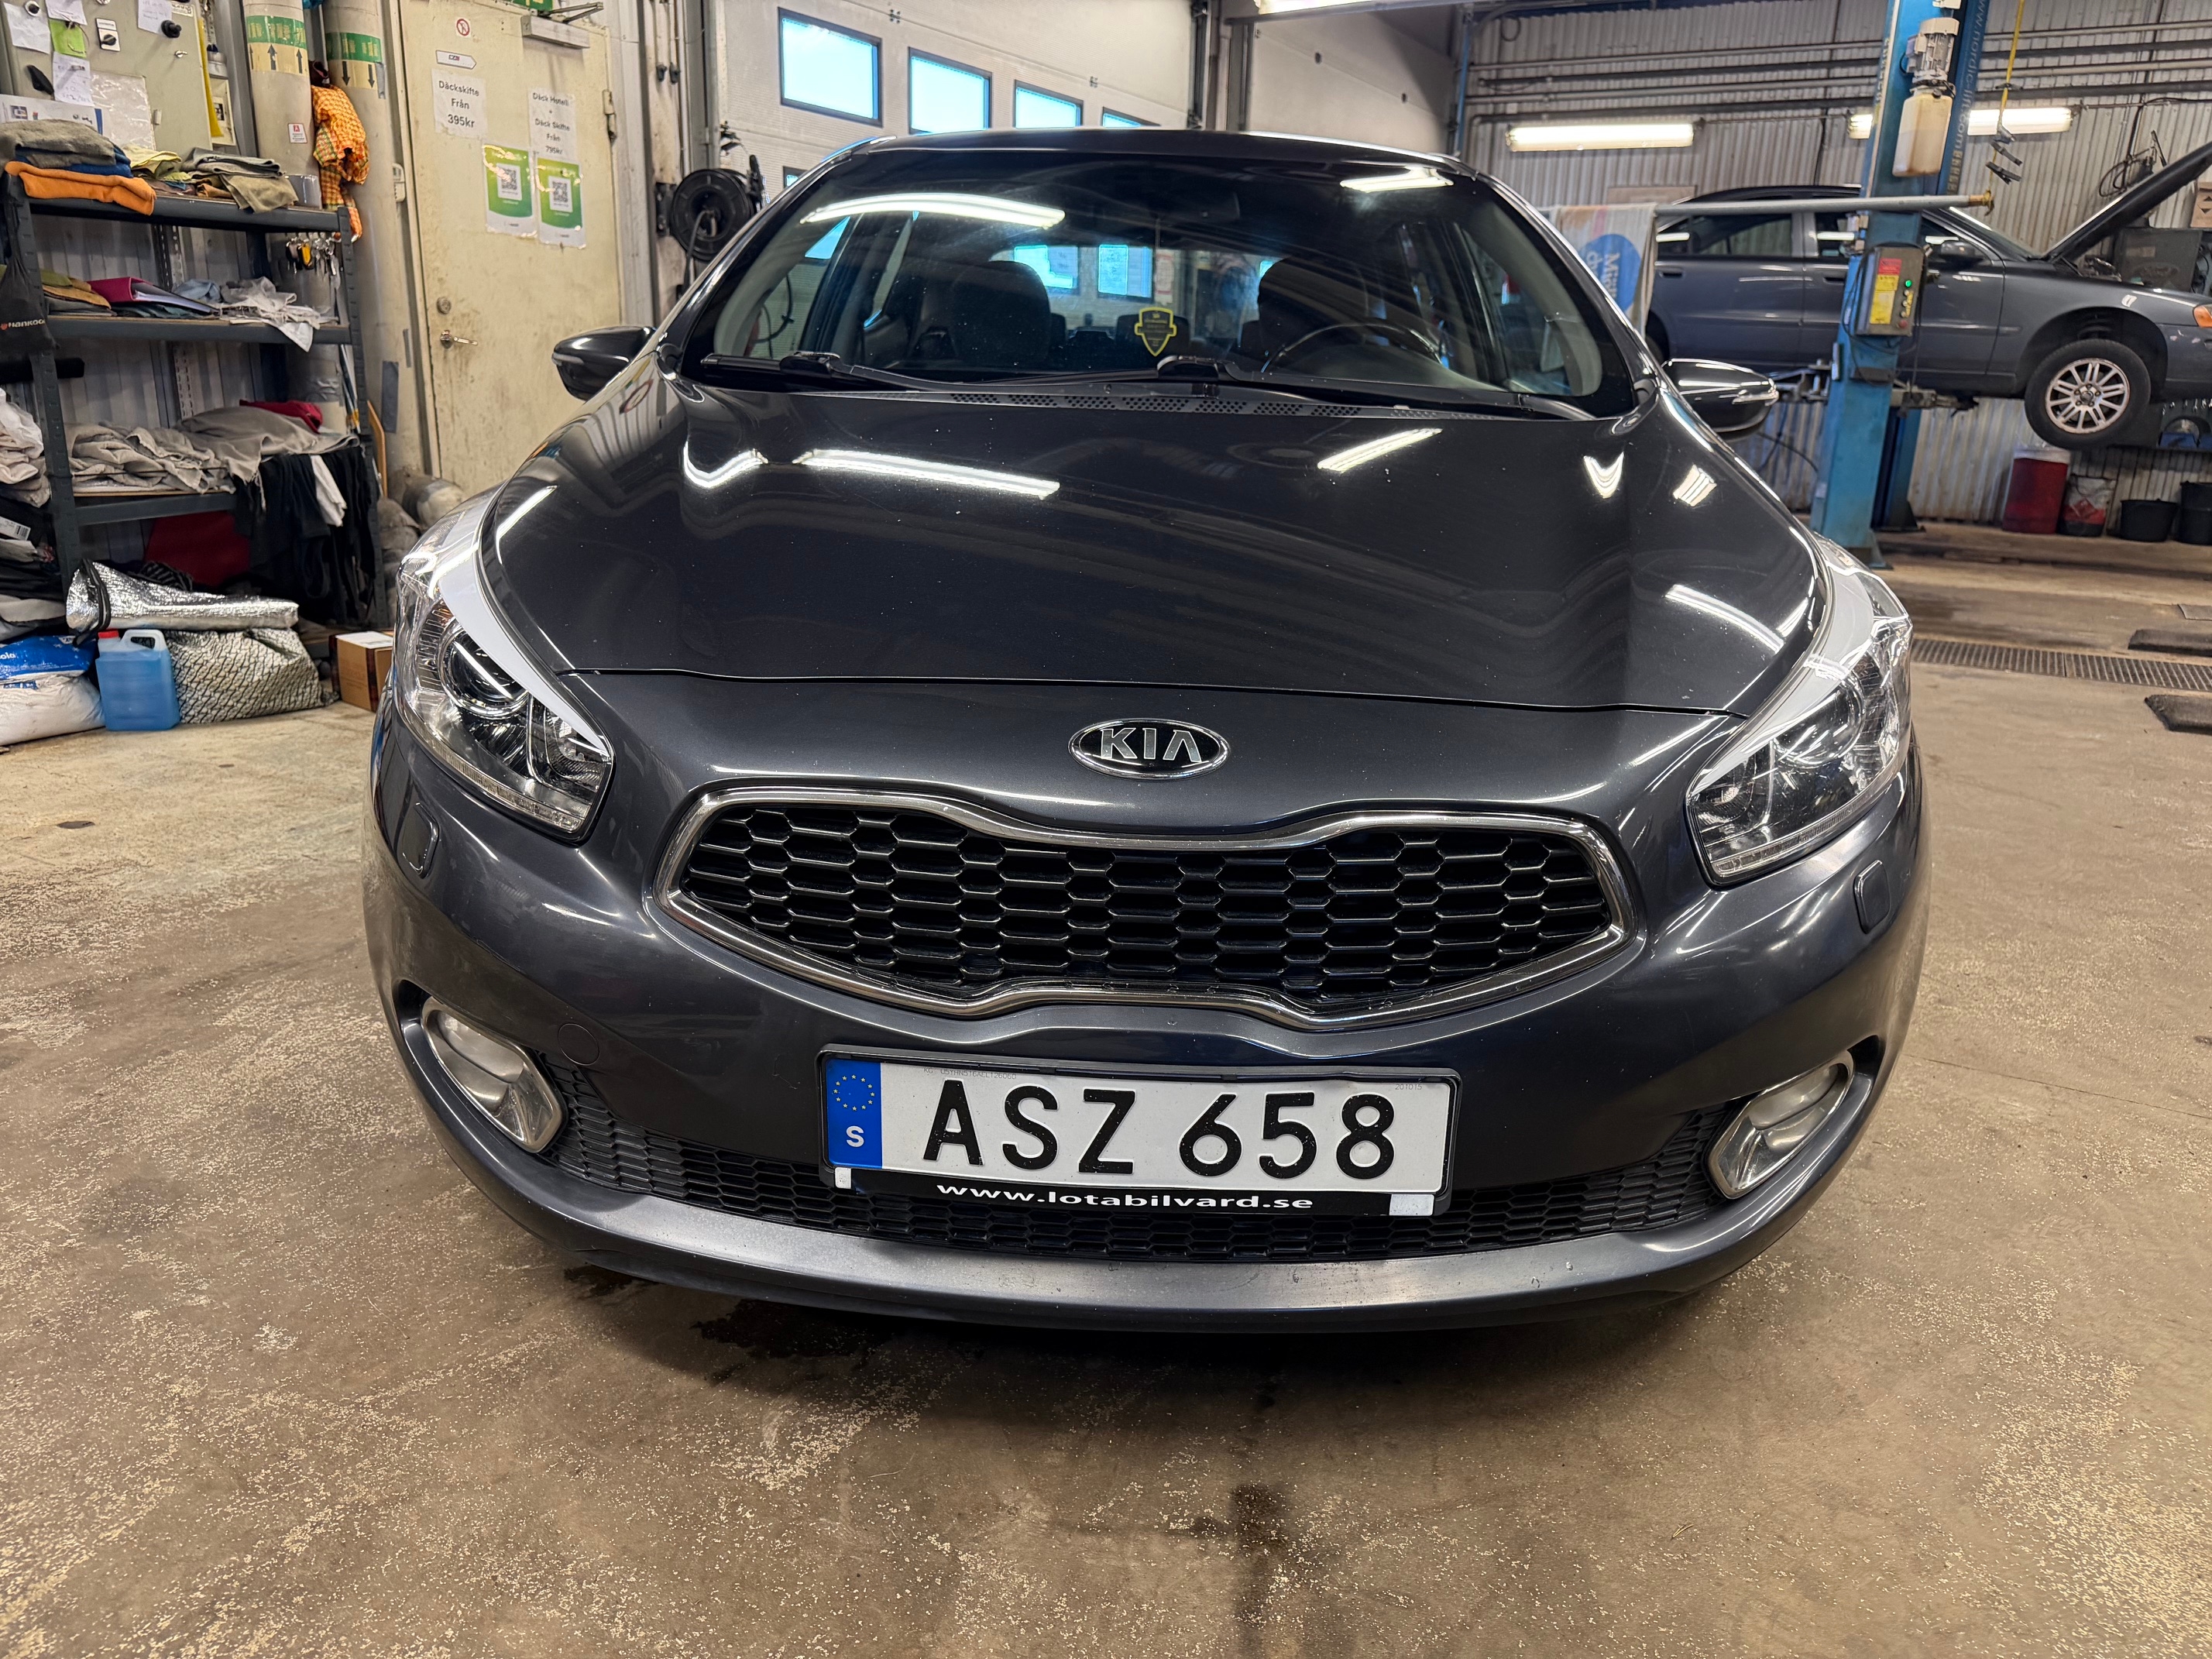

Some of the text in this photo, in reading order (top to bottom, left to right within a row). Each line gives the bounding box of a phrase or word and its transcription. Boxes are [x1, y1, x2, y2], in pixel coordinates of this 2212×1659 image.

[438, 80, 479, 97] Däckskifte
[451, 98, 470, 109] Från
[447, 113, 476, 128] 395kr
[1100, 727, 1202, 763] KIA
[846, 1125, 864, 1148] S
[922, 1078, 1396, 1180] ASZ 658
[936, 1184, 1314, 1210] www.lotabilvard.se
